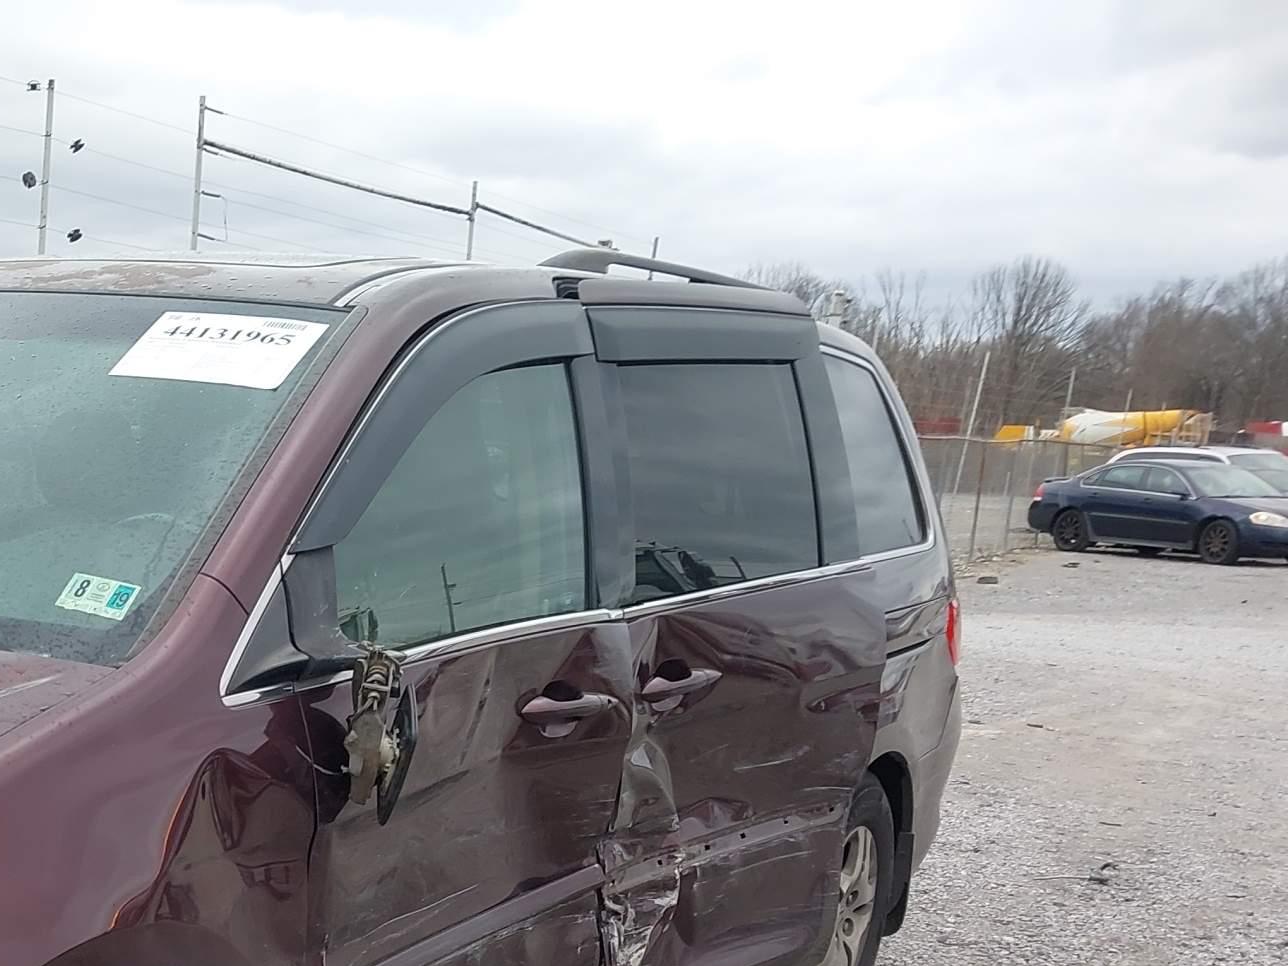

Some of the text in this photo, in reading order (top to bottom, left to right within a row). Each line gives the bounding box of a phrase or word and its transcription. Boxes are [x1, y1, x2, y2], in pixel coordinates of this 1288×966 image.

[163, 326, 295, 346] 44131965
[74, 580, 91, 597] 8
[109, 592, 129, 607] 19
